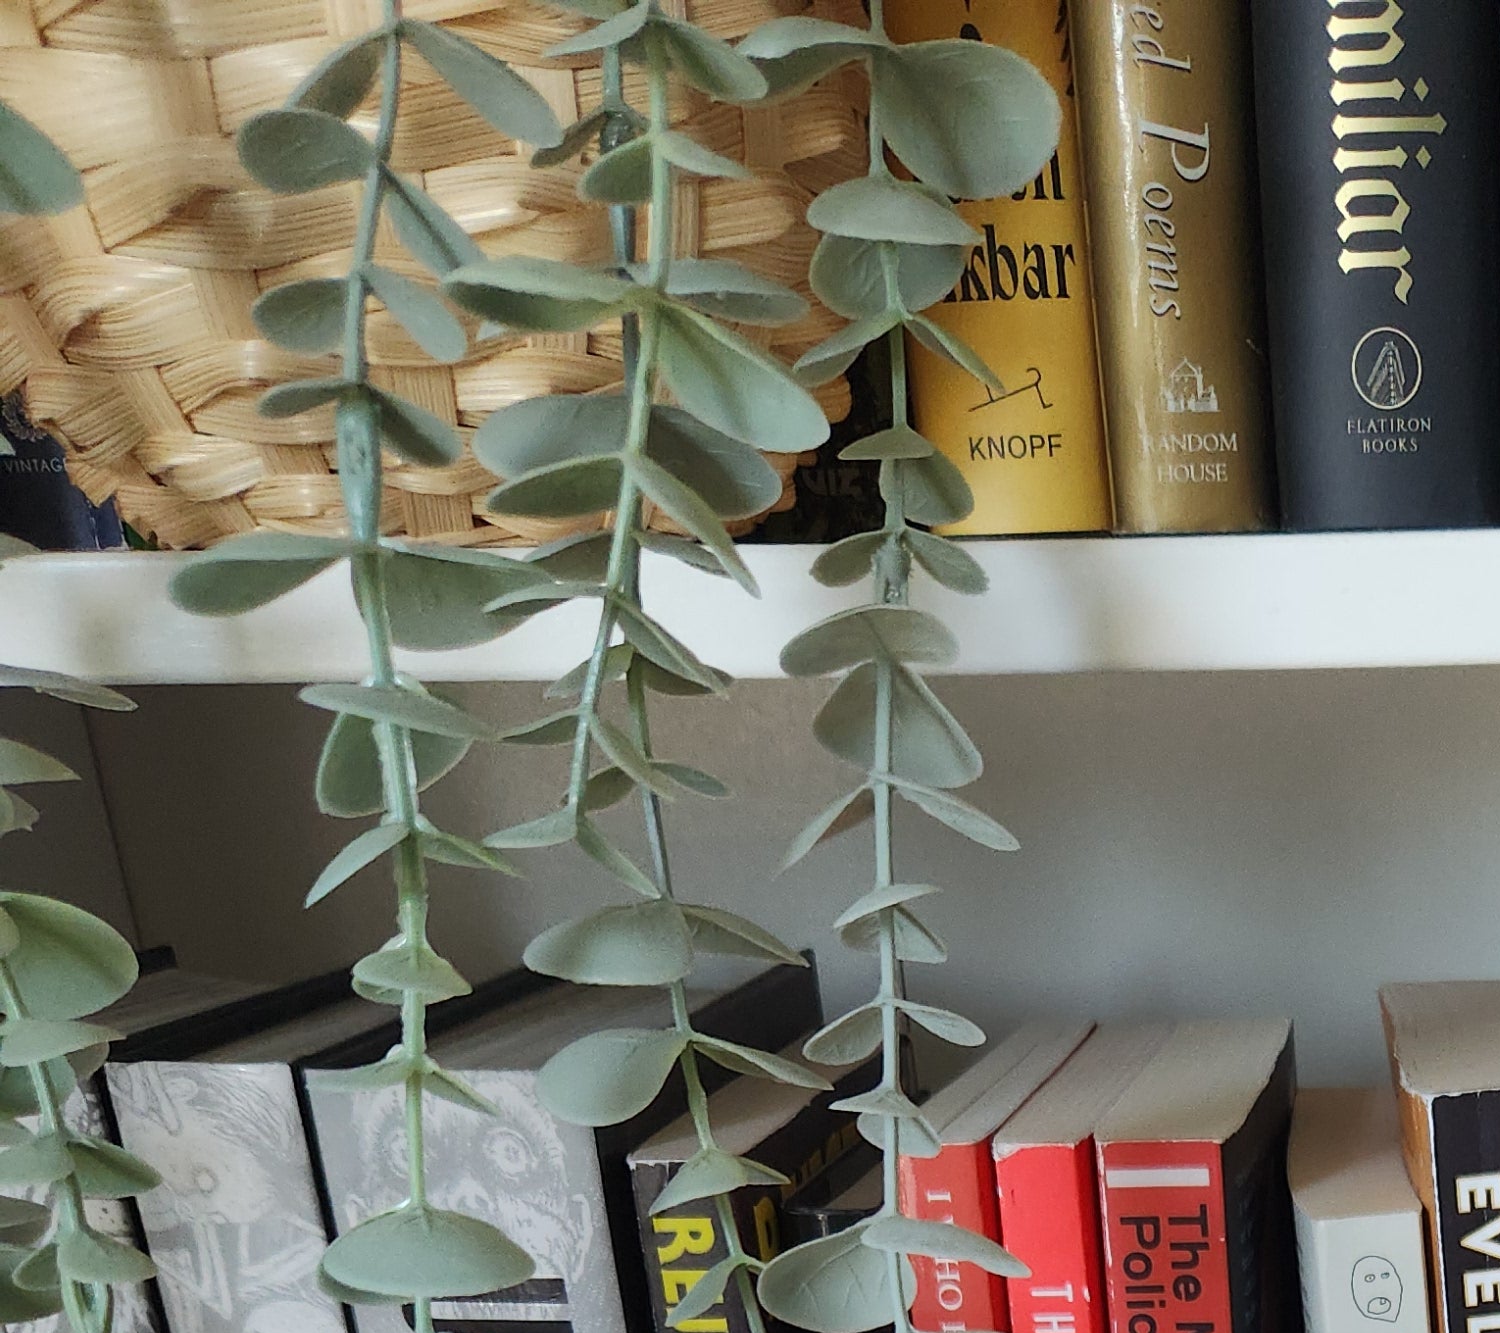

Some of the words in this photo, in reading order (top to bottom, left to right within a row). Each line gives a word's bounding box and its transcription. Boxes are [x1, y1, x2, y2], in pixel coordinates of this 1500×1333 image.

[1137, 120, 1210, 318] Poems
[1346, 417, 1432, 435] FLATIRON
[967, 432, 1064, 462] KNOPF
[1140, 430, 1238, 455] RANDOM
[1361, 437, 1419, 454] BOOKS
[1156, 462, 1229, 484] HOUSE
[1168, 1204, 1211, 1303] The
